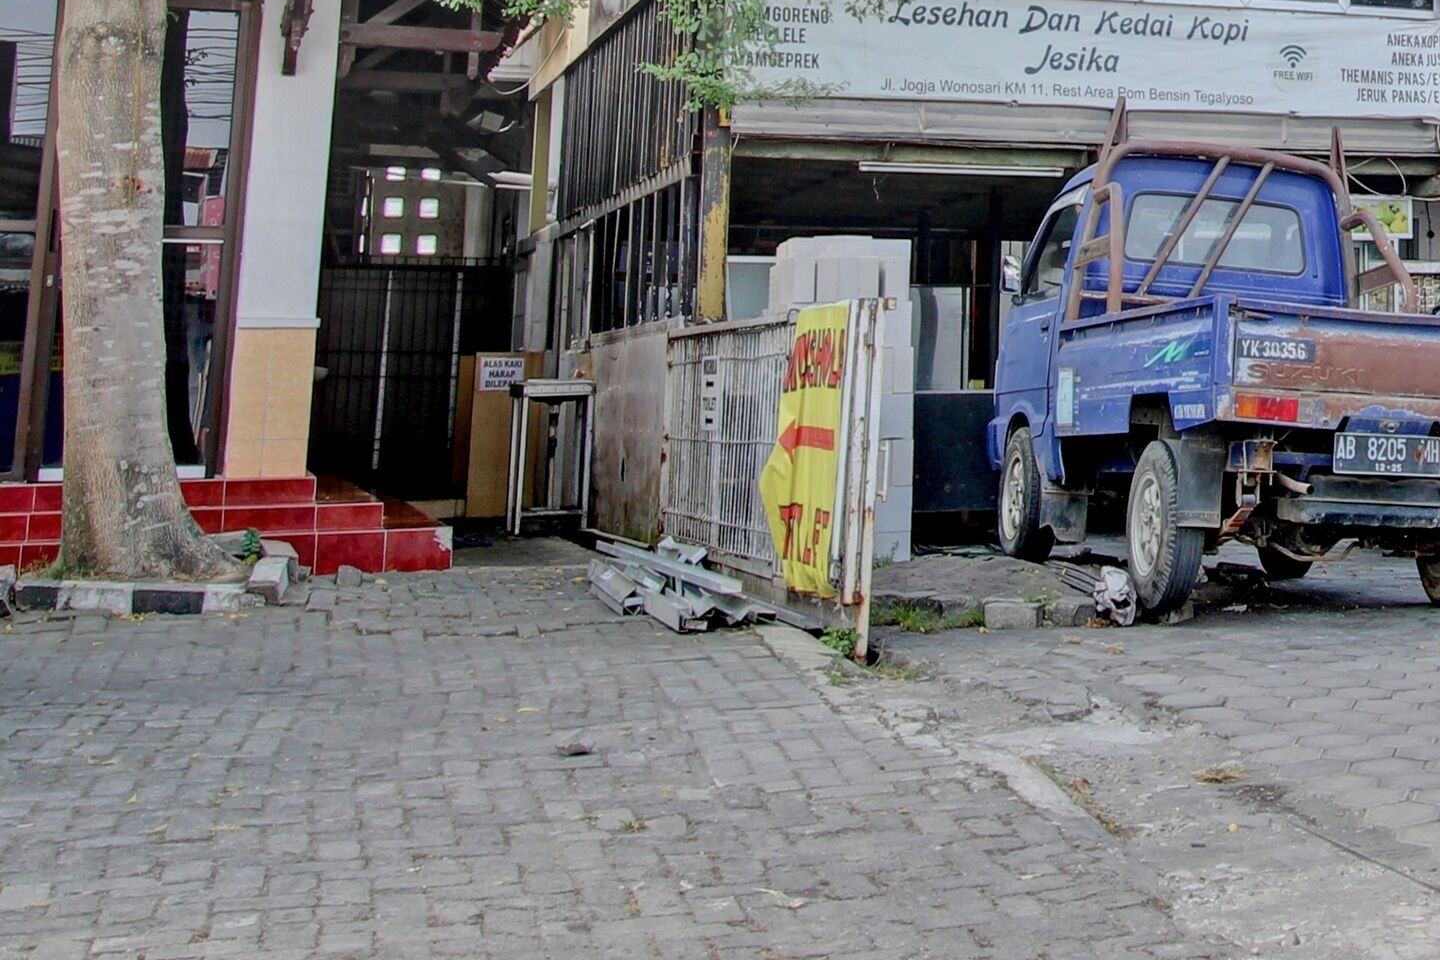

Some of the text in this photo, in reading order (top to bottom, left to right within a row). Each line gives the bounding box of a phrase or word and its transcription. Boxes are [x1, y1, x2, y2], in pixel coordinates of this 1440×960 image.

[1019, 5, 1080, 34] Dan
[1094, 10, 1173, 37] Kedai
[1187, 16, 1249, 45] Kopi
[1024, 45, 1120, 75] Jesika
[1391, 52, 1424, 67] ANEKA
[1273, 70, 1313, 81] FREE WIFI
[880, 78, 895, 91] Jl.
[900, 78, 936, 95] Jogja
[939, 79, 1001, 94] Wonosari
[1004, 81, 1026, 95] KM
[1053, 83, 1082, 97] Rest
[1084, 85, 1114, 99] Area
[1118, 86, 1145, 100] Pom
[1150, 88, 1190, 102] Bensin
[1194, 89, 1254, 106] Tegalyoso
[1356, 87, 1388, 103] JERUK
[489, 370, 516, 378] HARAP
[1336, 436, 1356, 460] AB
[1367, 437, 1407, 461] 8205
